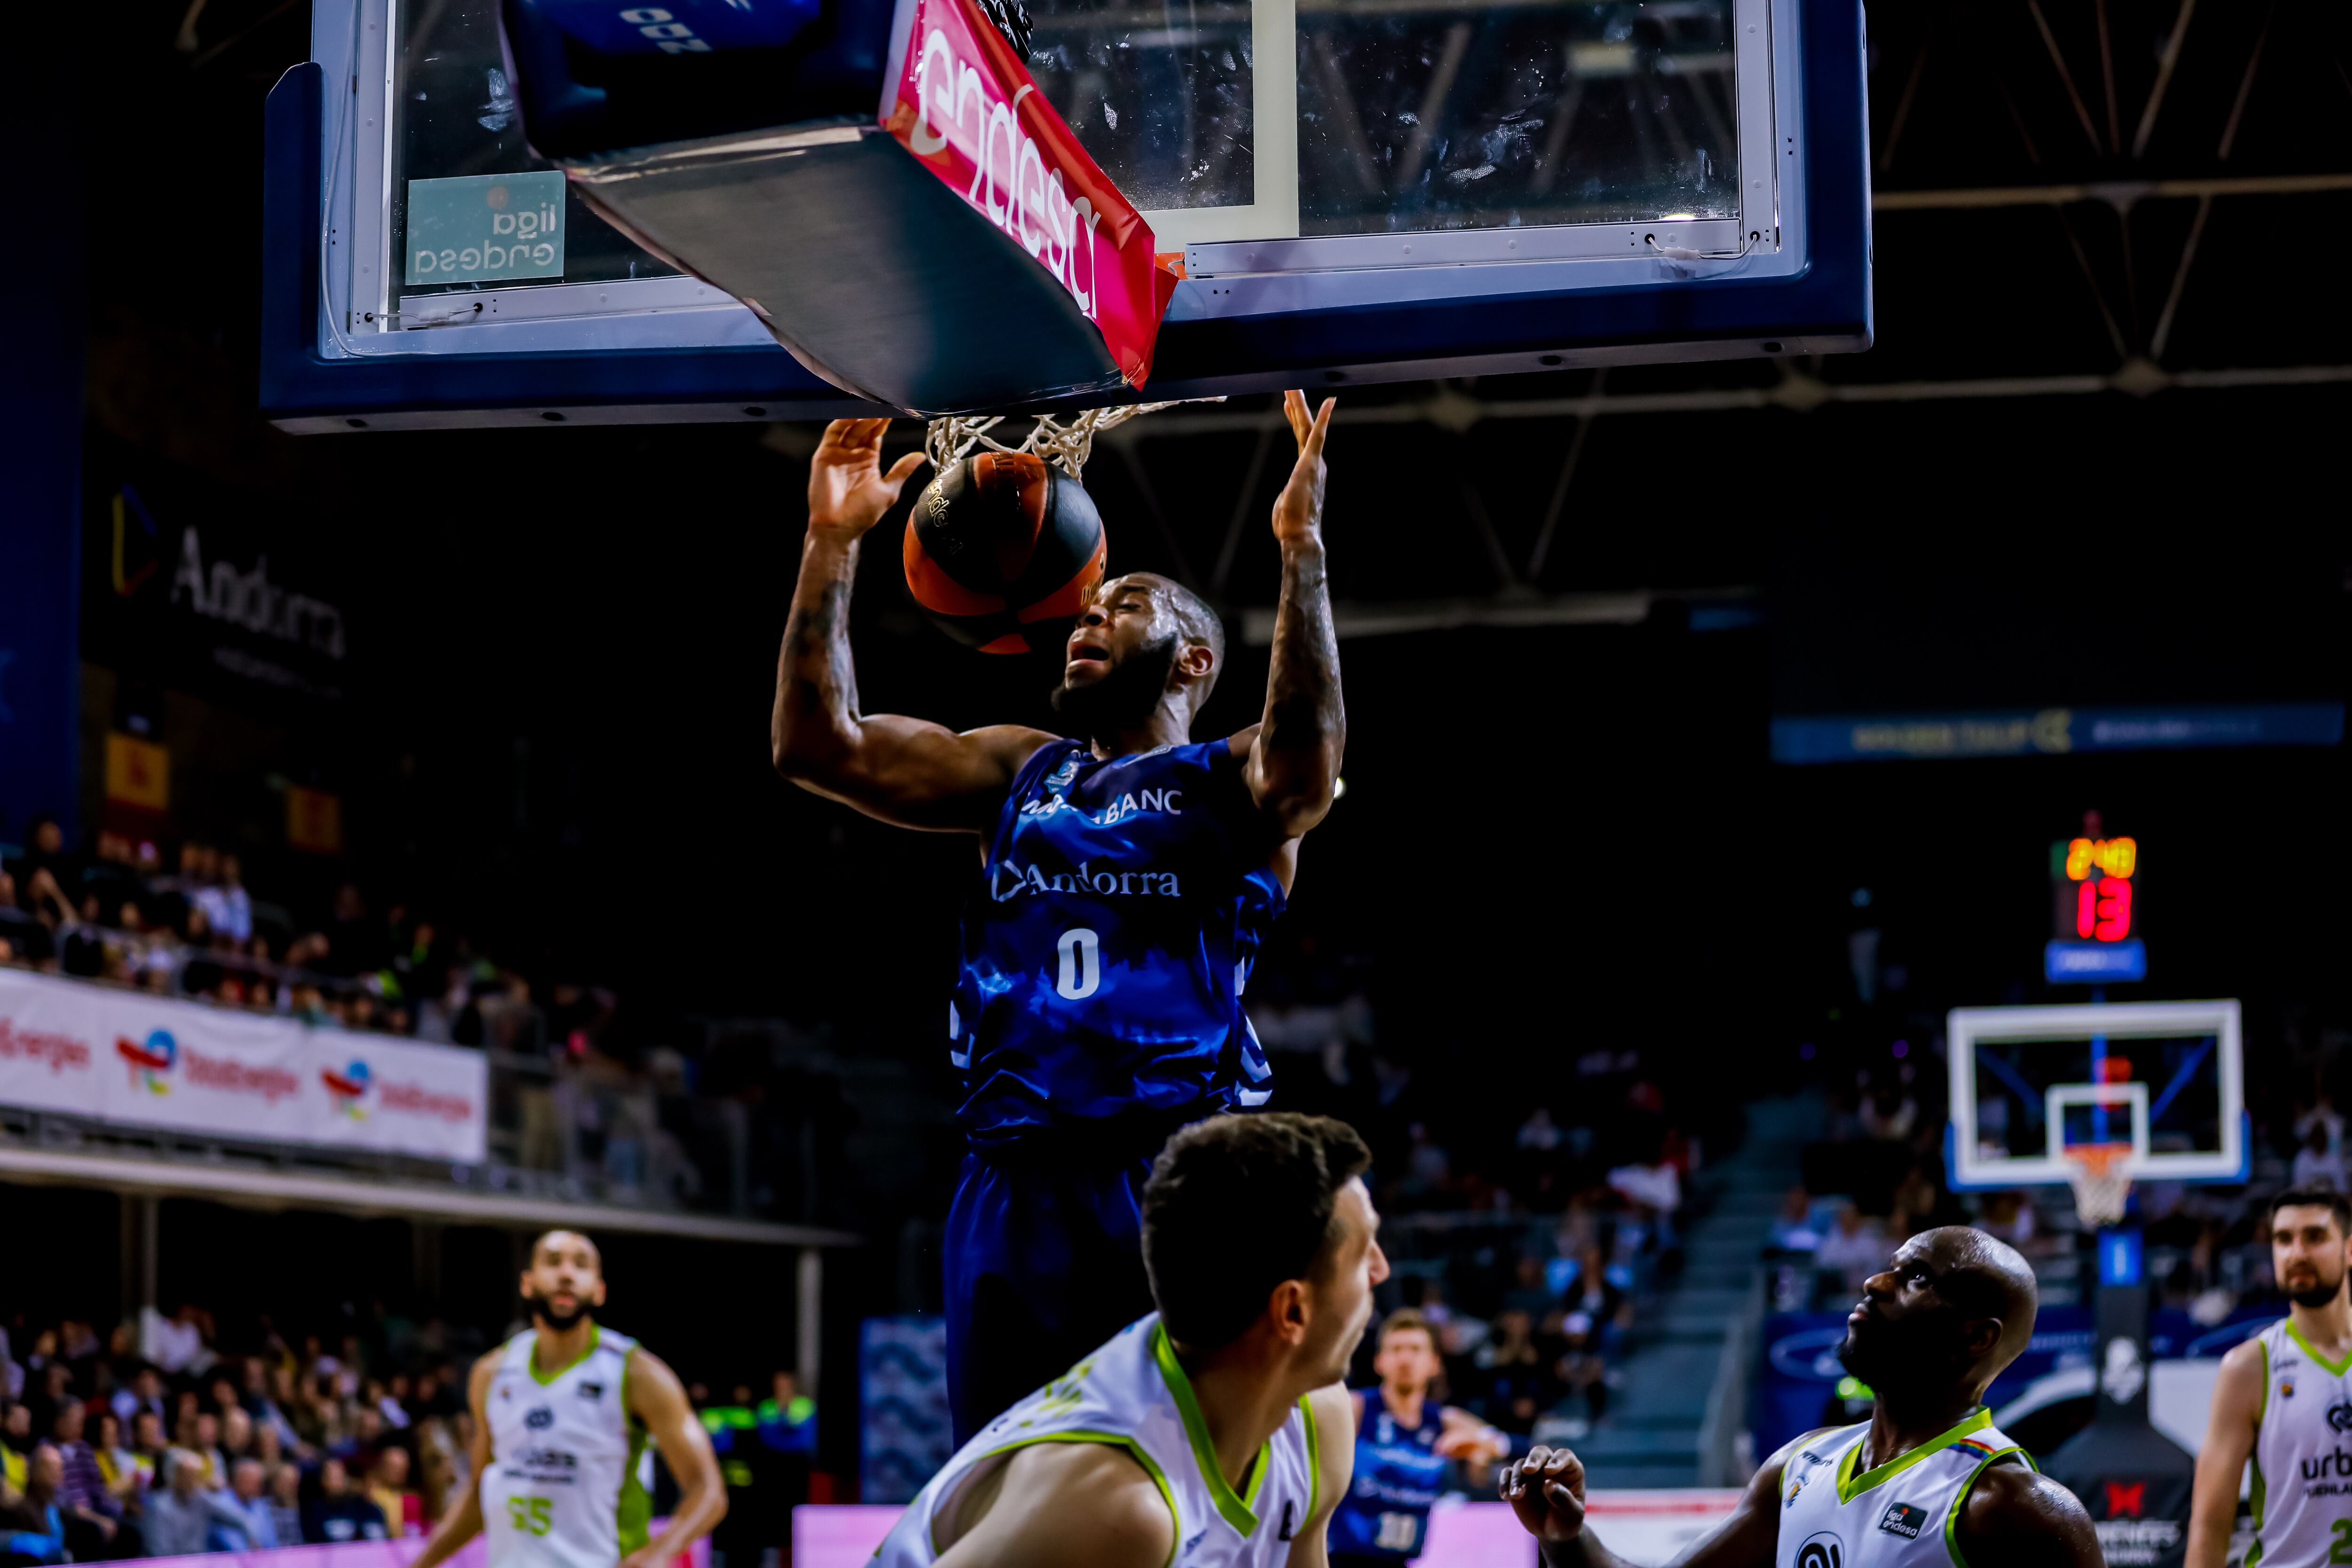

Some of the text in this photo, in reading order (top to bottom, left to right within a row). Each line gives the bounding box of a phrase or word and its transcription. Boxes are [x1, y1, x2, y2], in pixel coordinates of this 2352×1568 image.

[910, 28, 1102, 320] endesa
[1026, 861, 1182, 898] Andorra
[2076, 876, 2132, 941] 13
[1056, 927, 1100, 1000] 0
[1886, 1509, 1904, 1521] liga
